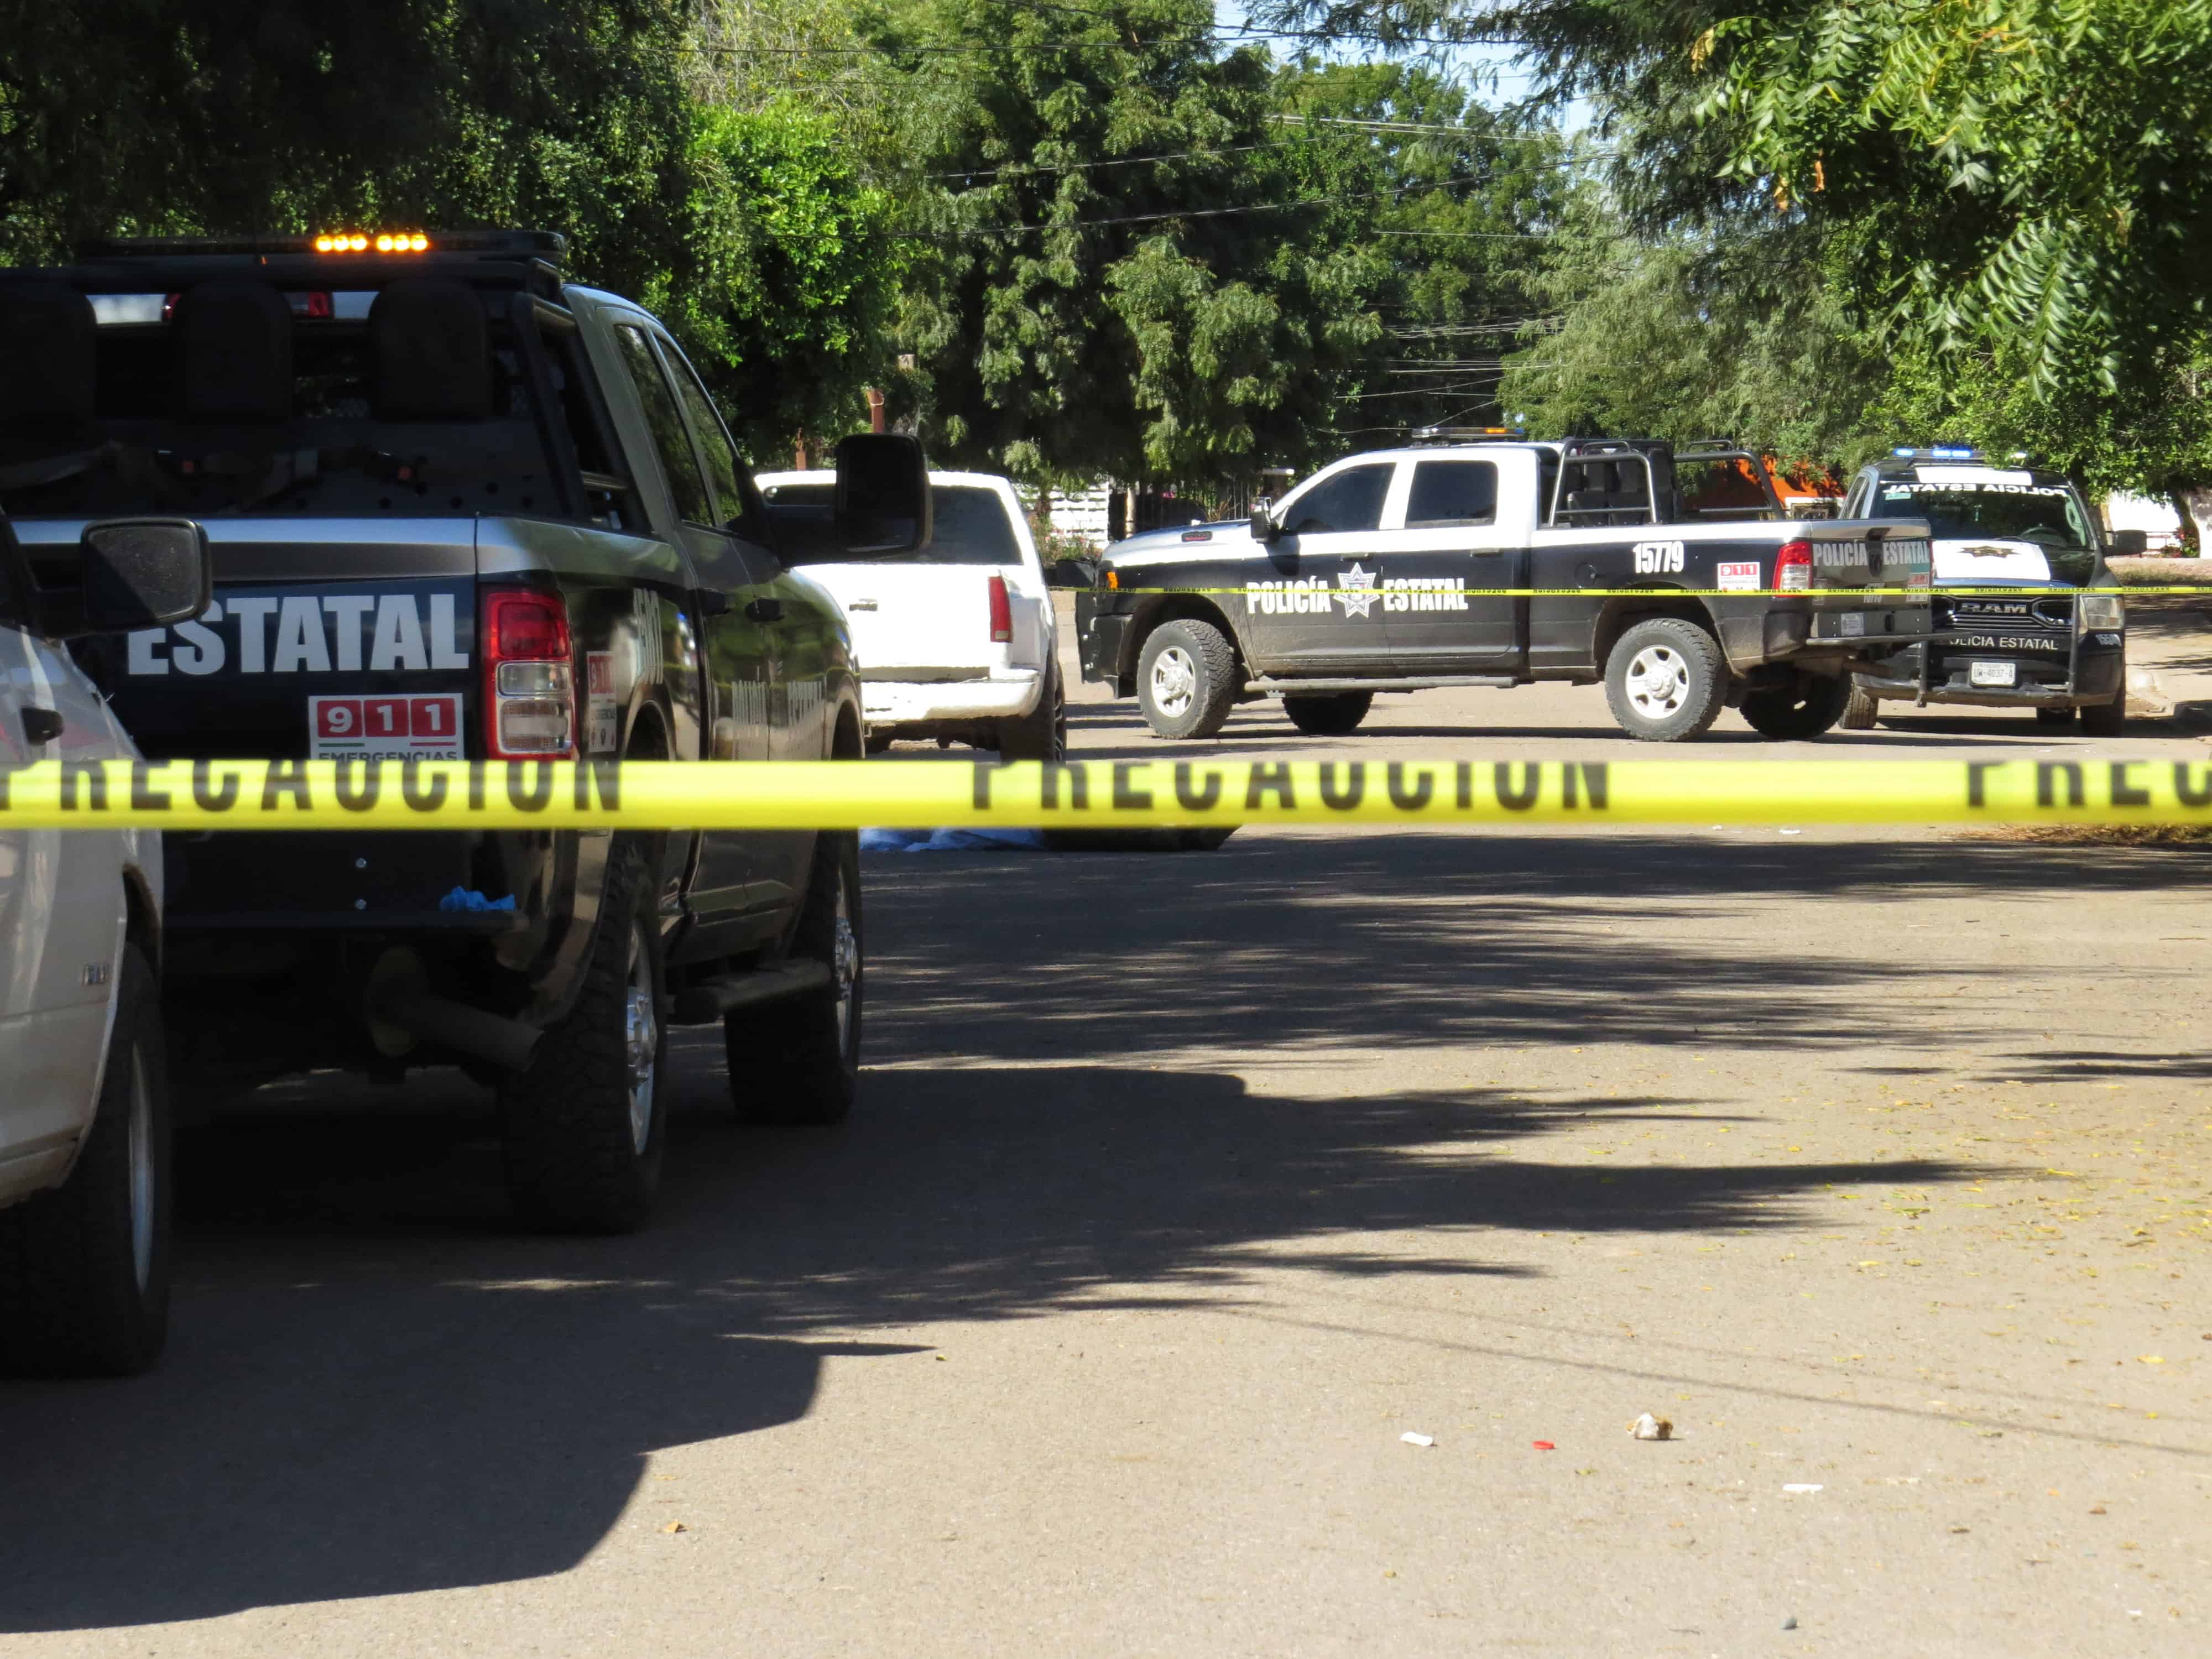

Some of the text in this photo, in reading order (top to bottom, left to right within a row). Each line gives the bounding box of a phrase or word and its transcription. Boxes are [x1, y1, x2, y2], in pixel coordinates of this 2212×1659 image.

[1632, 540, 1684, 573] 15779
[1812, 539, 1930, 567] POLICÍA ESTATAL
[1722, 565, 1755, 575] 911
[1246, 575, 1469, 614] POLICÍA ESTATAL
[1960, 602, 2027, 614] RAM
[128, 593, 469, 676] ESTATAL
[1999, 637, 2059, 650] ESTATAL
[326, 703, 441, 734] 911
[318, 751, 457, 761] EMERGENCIAS
